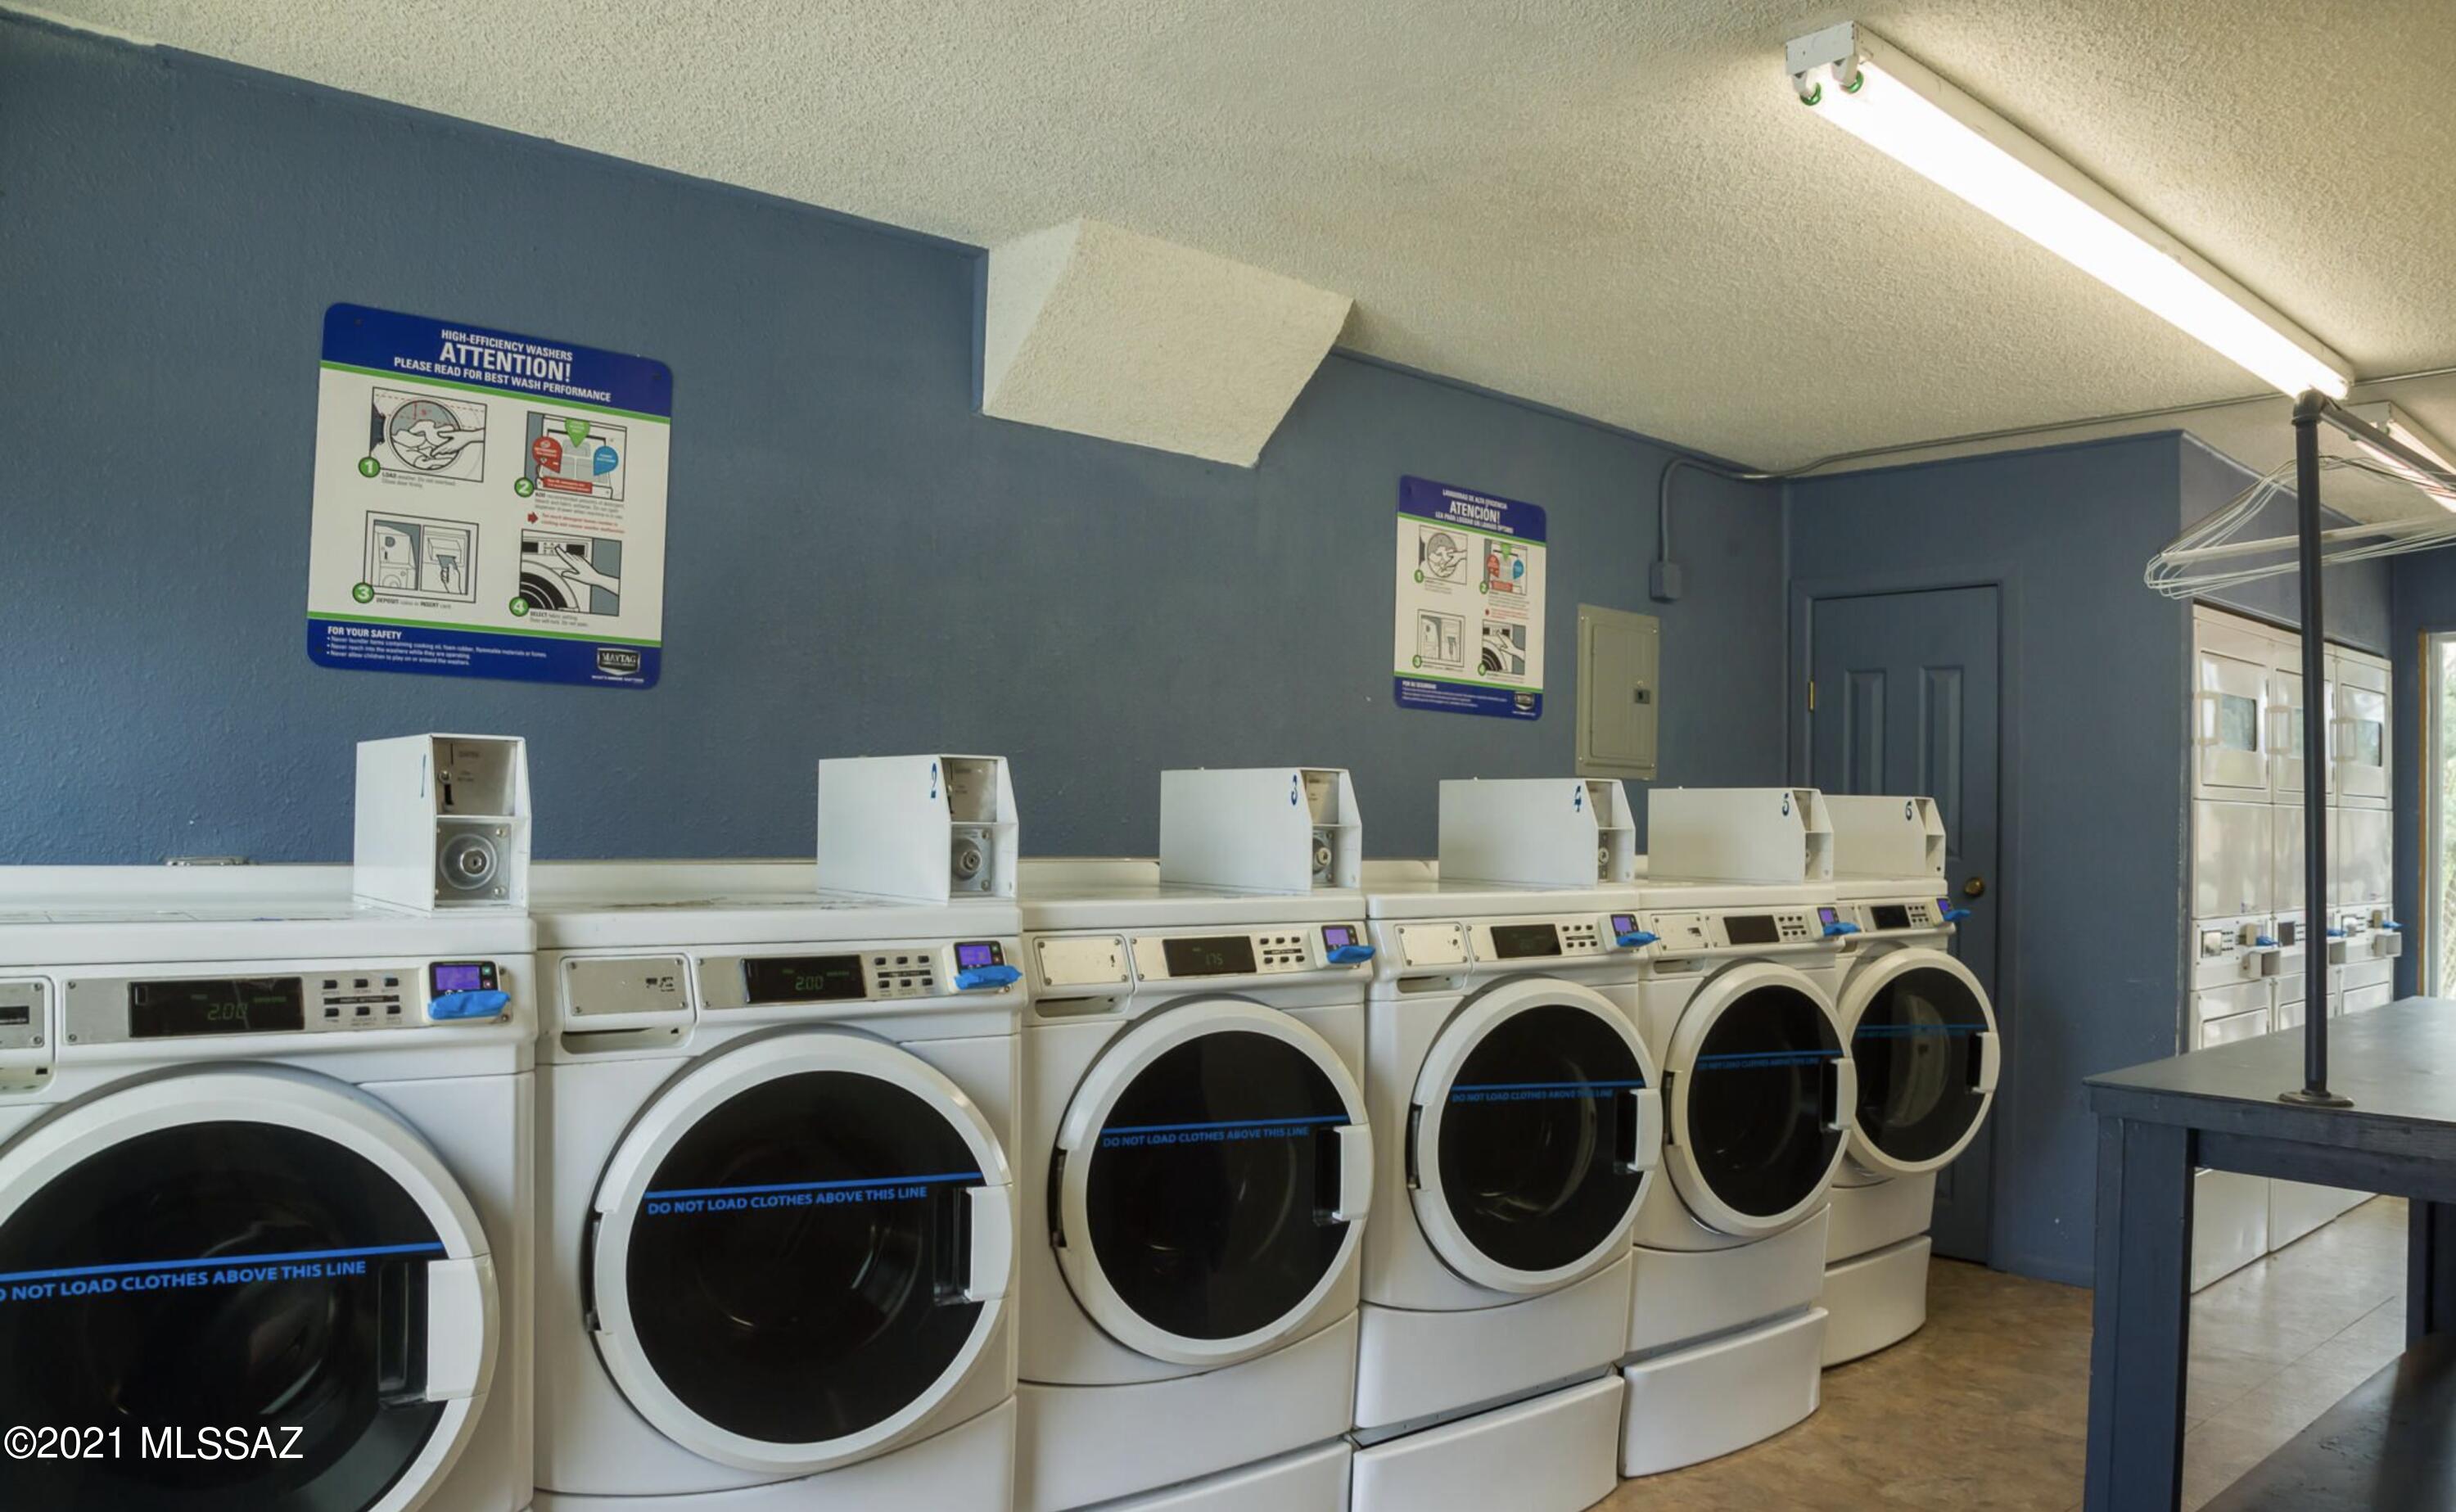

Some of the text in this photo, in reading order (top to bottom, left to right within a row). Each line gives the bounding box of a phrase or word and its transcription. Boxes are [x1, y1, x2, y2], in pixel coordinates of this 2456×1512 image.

[440, 329, 573, 362] HIGH-EFFICIENCY WASHERS
[439, 341, 571, 383] ATTENTION!
[394, 357, 612, 403] PLEASE READ FOR BEST WASH PERFORMANCE
[1450, 500, 1501, 524] ATENCIÓN!
[327, 625, 402, 639] FOR YOUR SAFETY
[602, 652, 636, 663] MAYTAG
[931, 763, 937, 798] 2
[1291, 774, 1298, 806] 3
[1574, 785, 1582, 812] 4
[1782, 792, 1790, 817] 5
[1905, 801, 1912, 821] 6
[207, 1002, 249, 1021] 2.00
[1104, 1126, 1309, 1148] DO NOT LOAD CLOTHES ABOVE THIS LINE
[648, 1185, 928, 1215] DO NOT LOAD CLOTHES ABOVE THIS LINE
[12, 1283, 56, 1301] NOT
[60, 1277, 118, 1297] LOAD
[121, 1271, 209, 1292] CLOTHES
[213, 1266, 278, 1284] ABOVE
[282, 1262, 322, 1280] THIS
[327, 1260, 367, 1277] LINE
